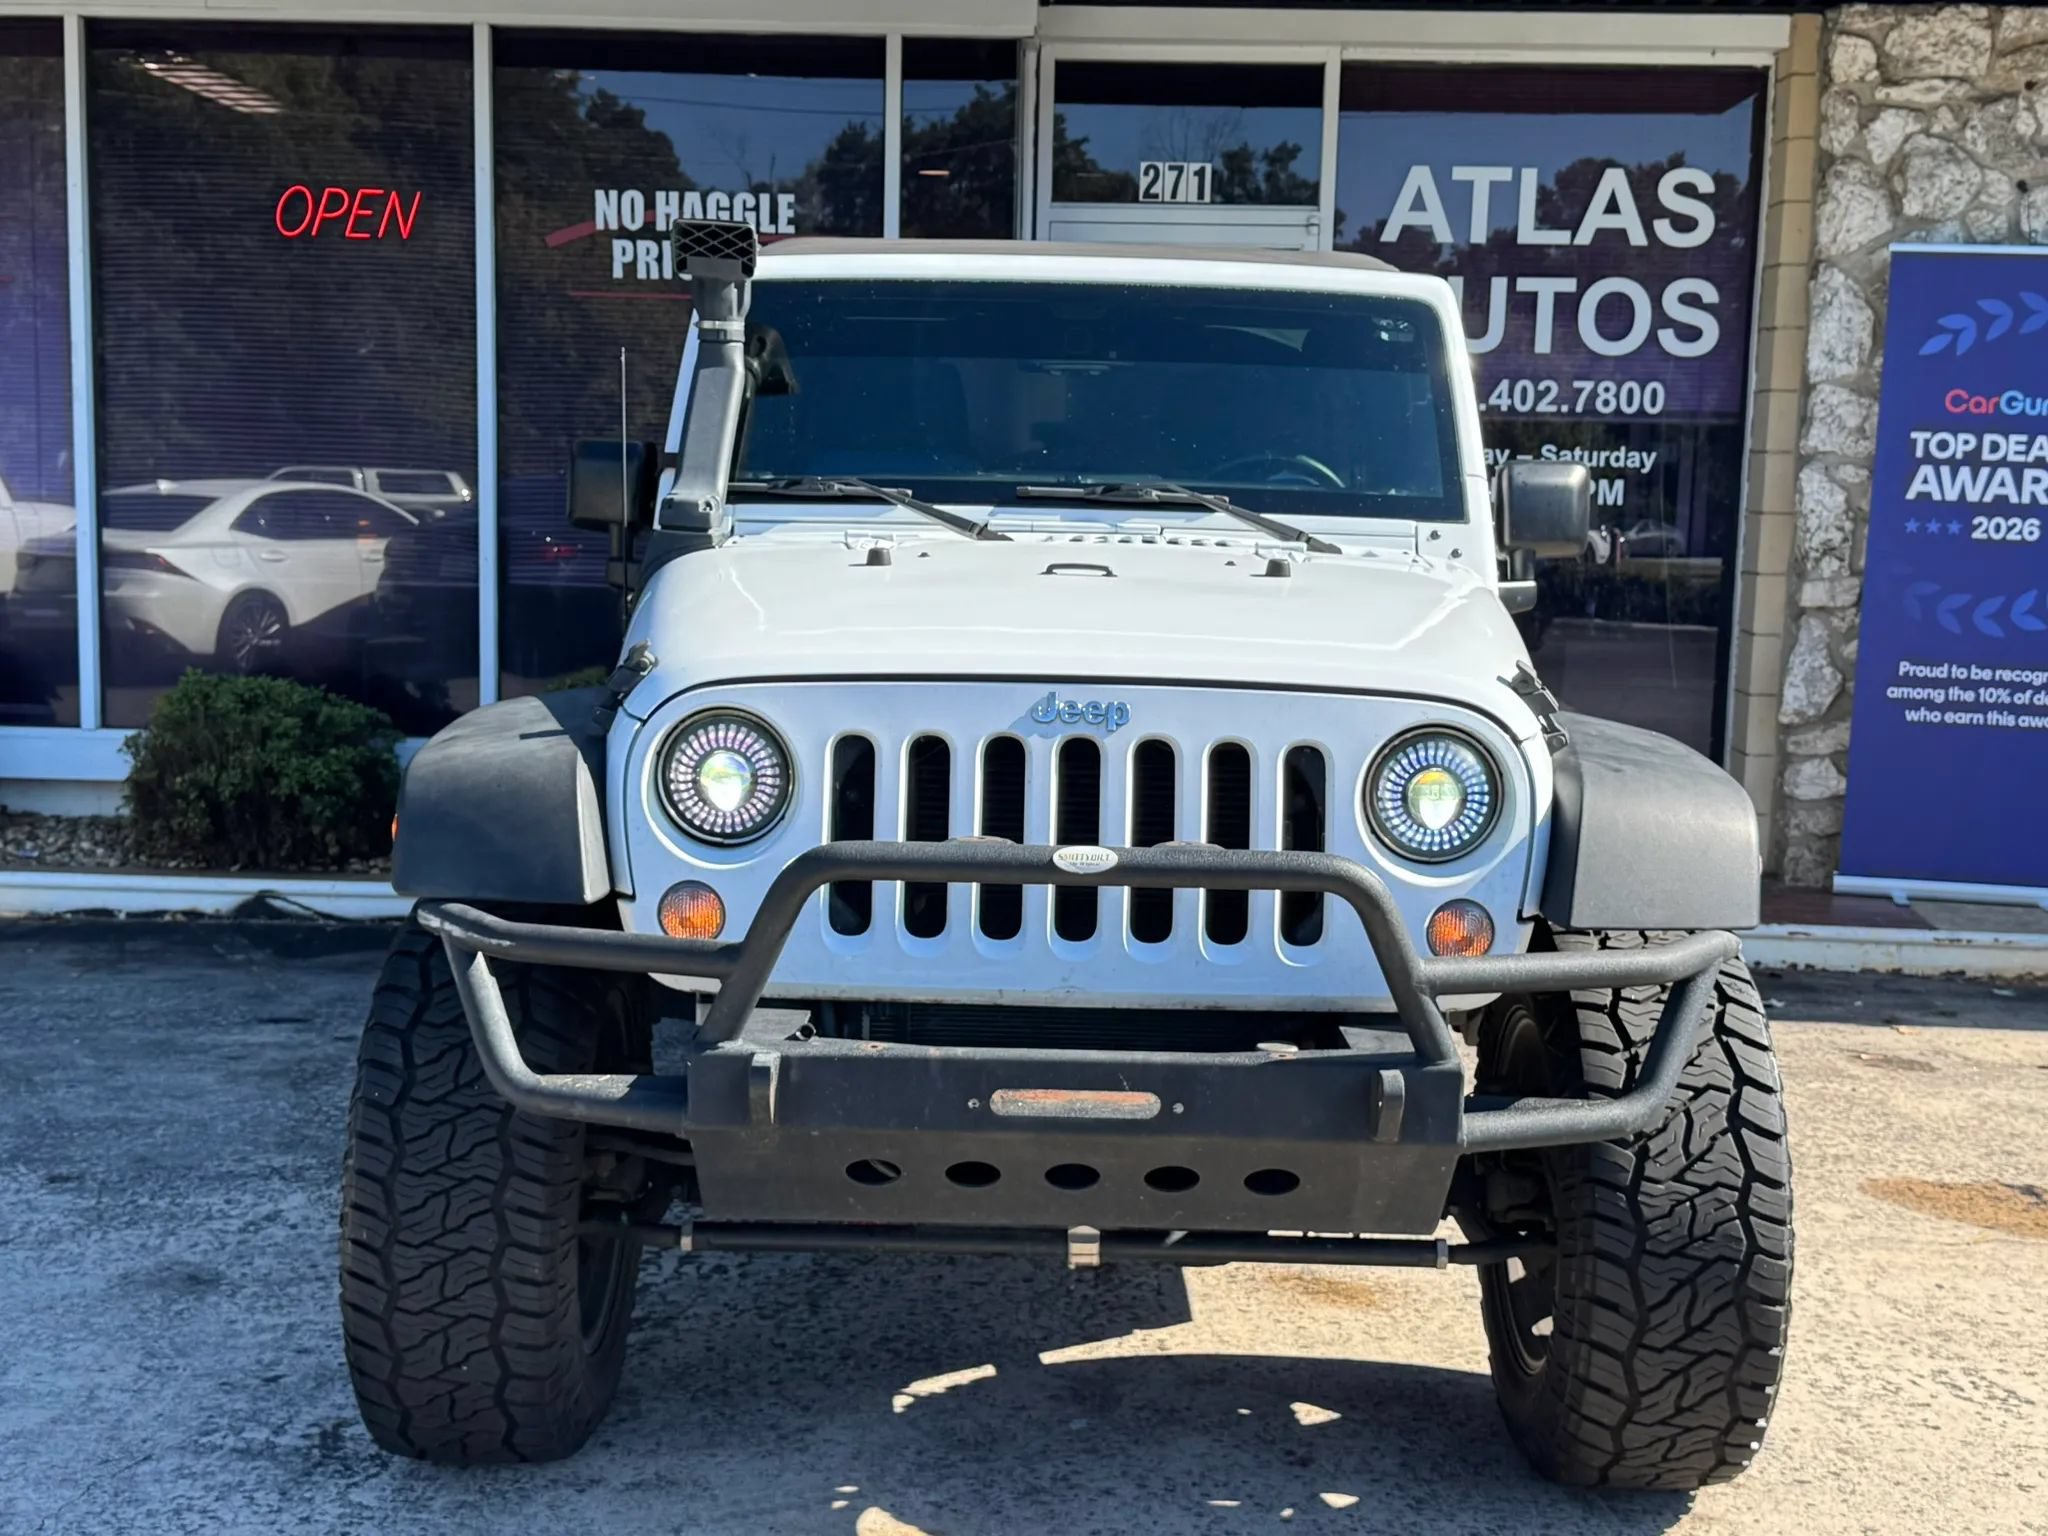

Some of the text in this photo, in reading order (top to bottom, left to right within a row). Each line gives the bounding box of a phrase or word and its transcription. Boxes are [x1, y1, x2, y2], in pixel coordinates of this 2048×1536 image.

[1142, 163, 1206, 201] 271
[274, 184, 421, 240] OPEN
[594, 189, 795, 234] NO HAGGLE
[1380, 164, 1715, 249] ATLAS
[612, 239, 693, 281] PRI
[1448, 275, 1720, 357] UTOS
[1480, 379, 1665, 415] .402.7800
[1540, 444, 1657, 474] Saturday
[1910, 431, 2048, 463] TOP DEA
[1905, 464, 2048, 505] AWAR
[1971, 515, 2041, 542] 2026
[1898, 661, 1949, 679] Proud
[1951, 664, 1968, 680] to
[1971, 664, 1993, 681] be
[1031, 691, 1131, 732] Jeep
[1886, 686, 1945, 704] among
[1948, 686, 1975, 702] the
[1979, 687, 2011, 704] 10%
[2013, 689, 2033, 705] of
[1905, 707, 1942, 723] who
[1944, 711, 1984, 725] earn
[1986, 710, 2016, 727] this
